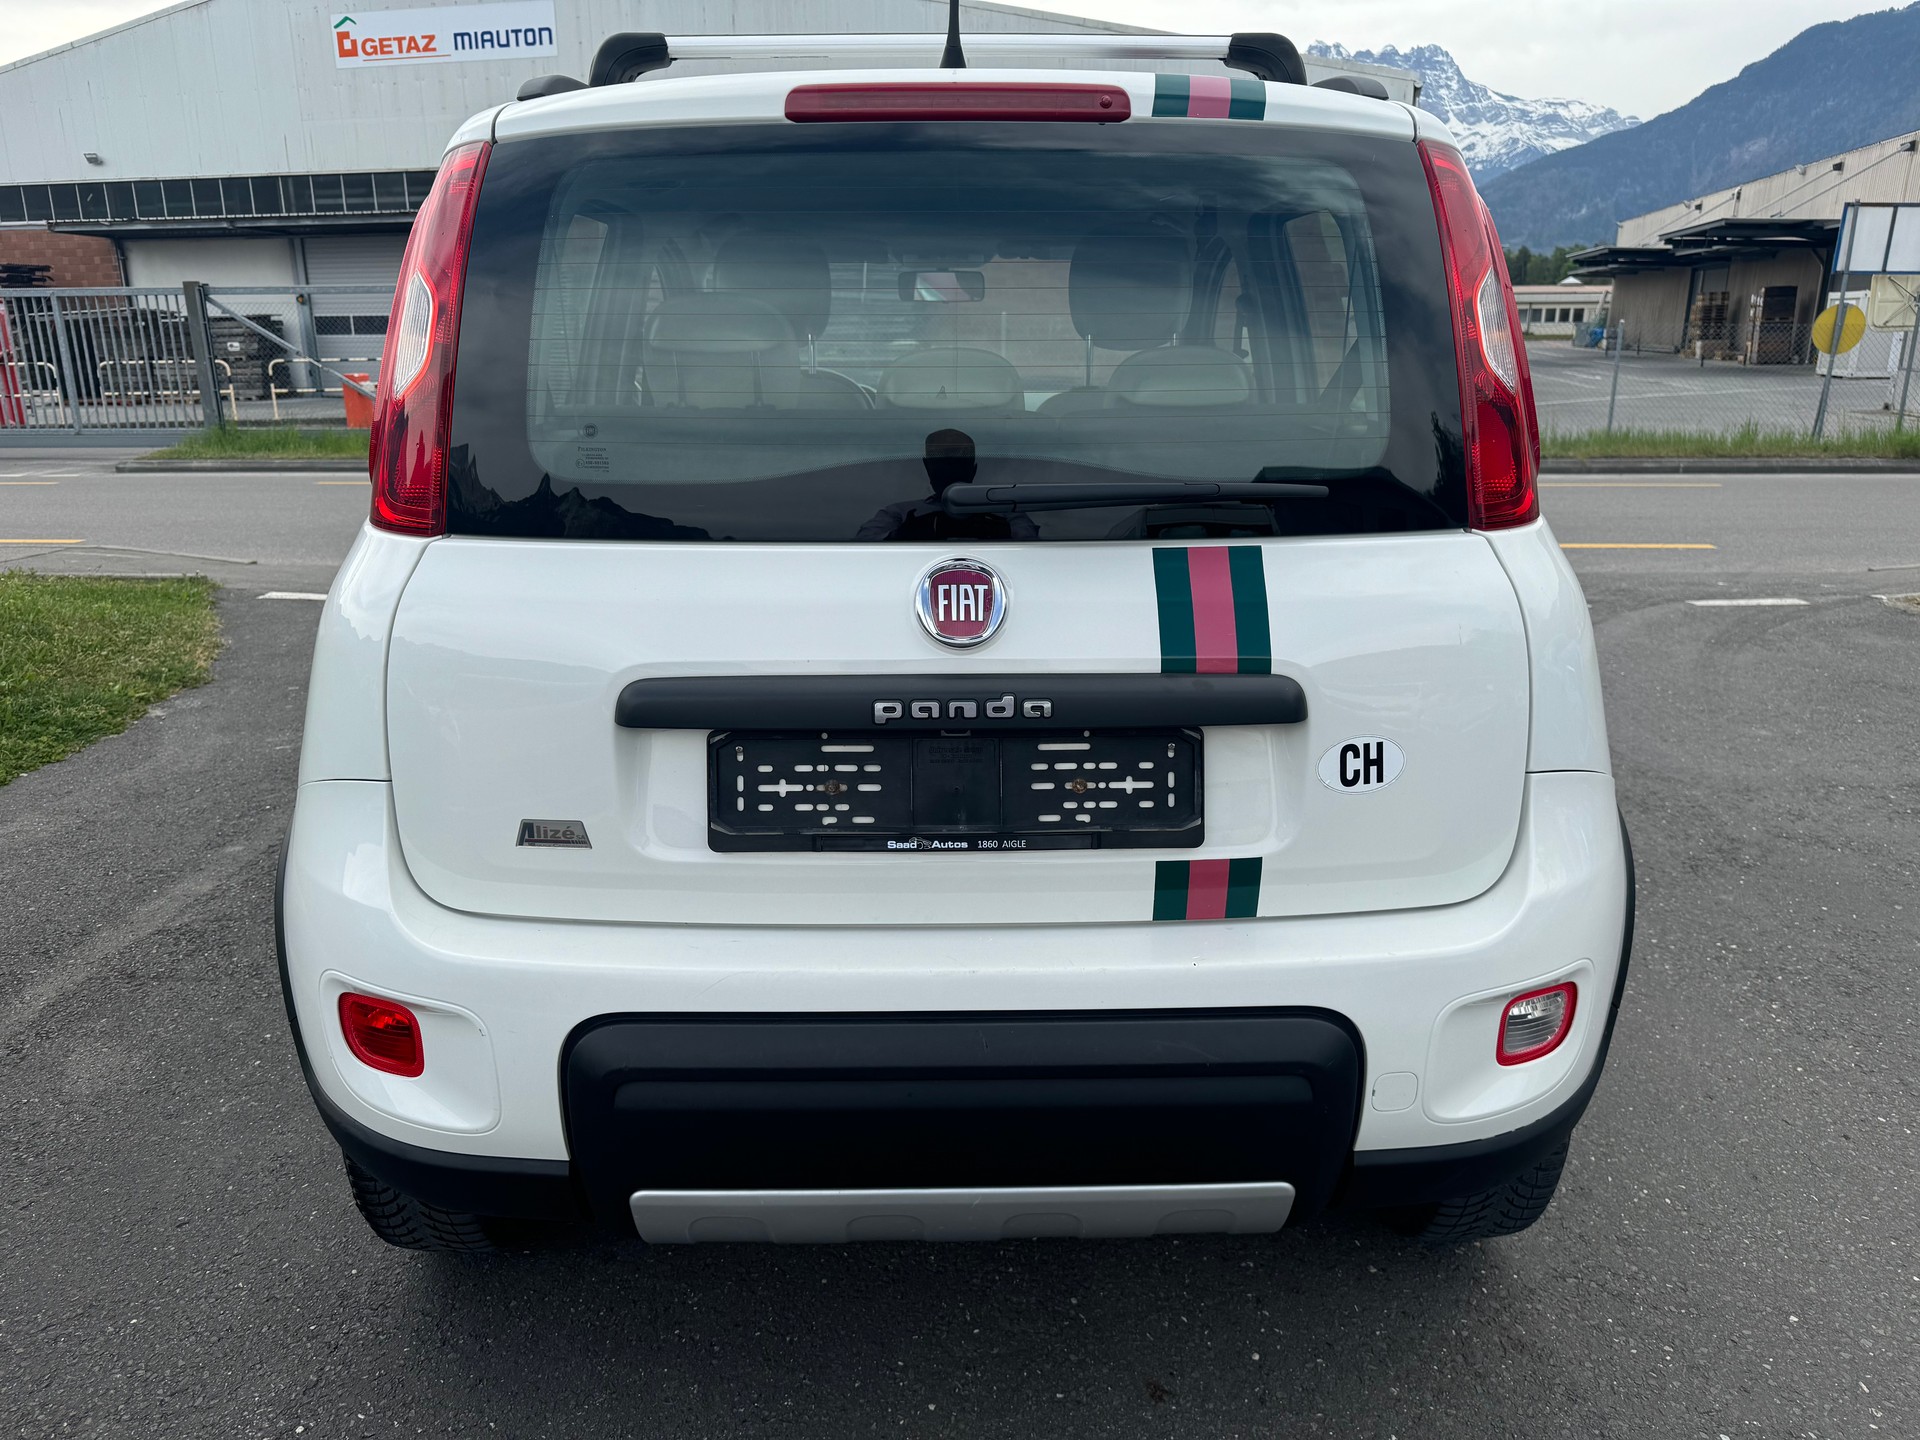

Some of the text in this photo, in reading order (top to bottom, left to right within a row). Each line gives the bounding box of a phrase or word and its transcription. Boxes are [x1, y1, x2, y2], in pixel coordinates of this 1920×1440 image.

[361, 27, 553, 56] GETAZ MIAUTON
[937, 584, 989, 622] FIAT
[873, 695, 1052, 724] panda
[1339, 741, 1384, 787] CH
[887, 839, 1027, 849] Saad Autos 1860 AIGLE
